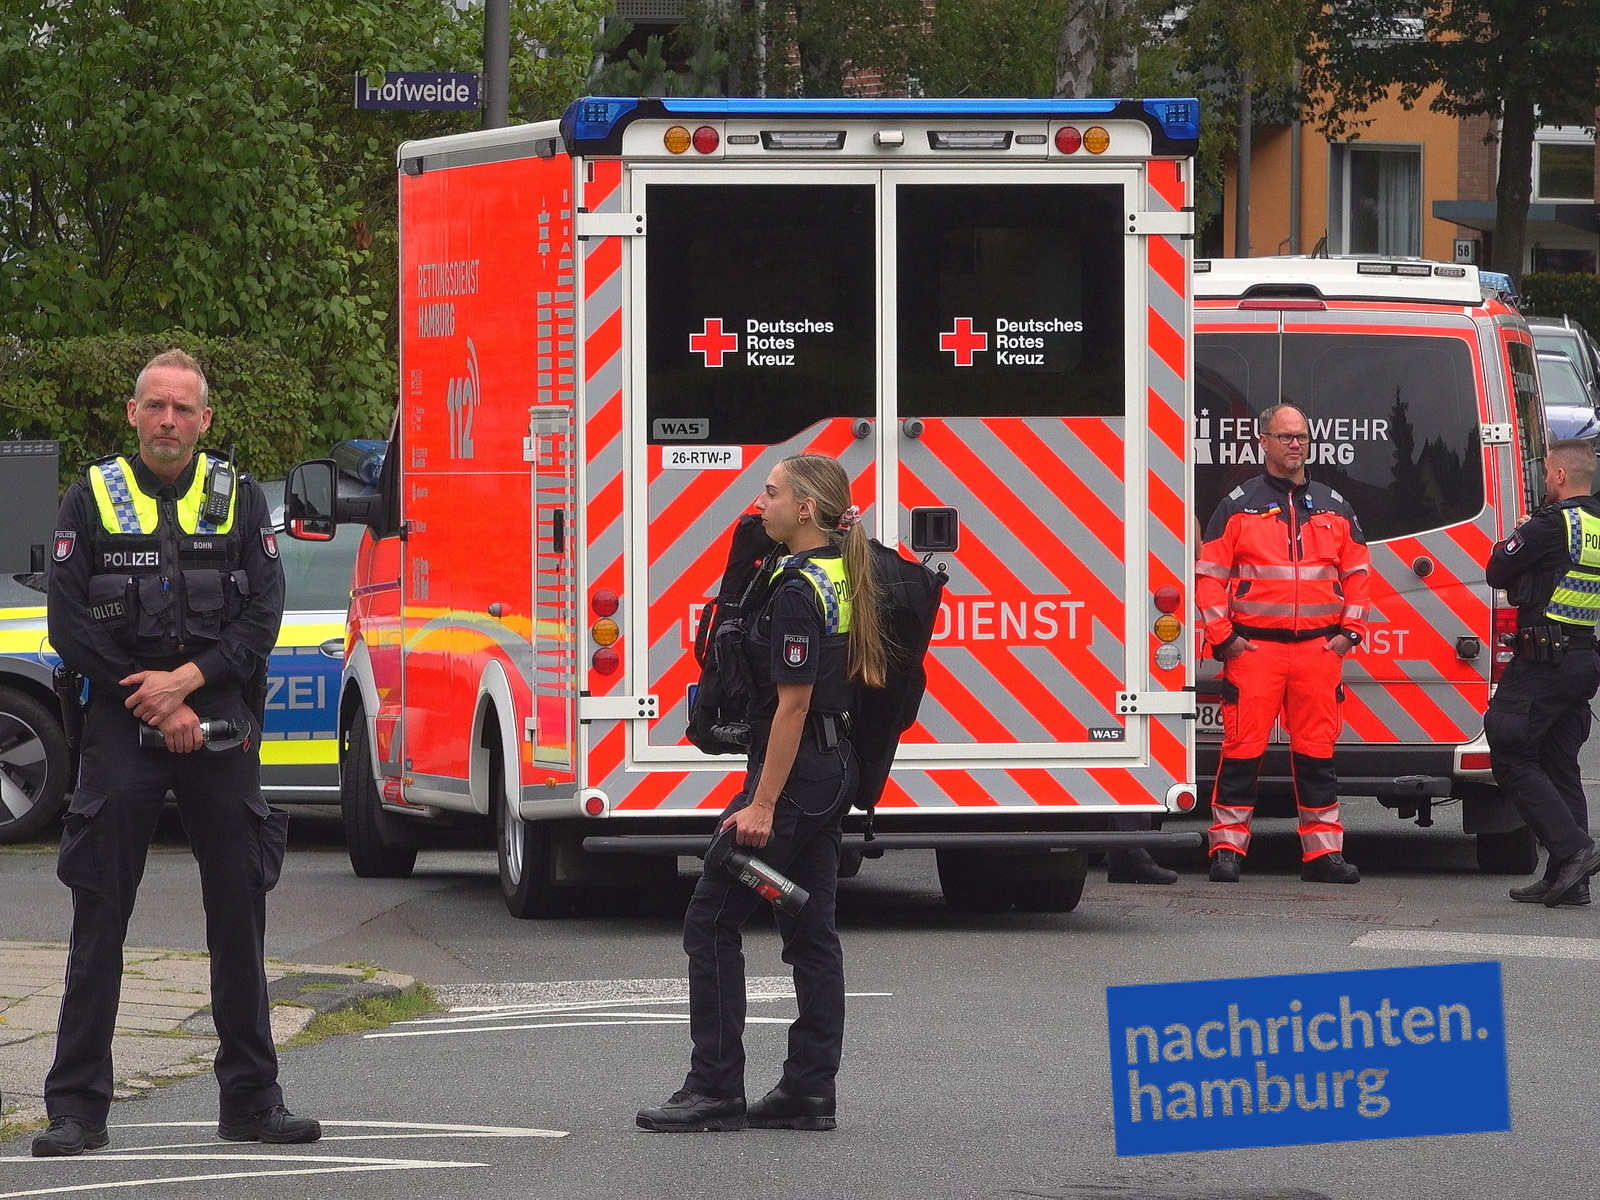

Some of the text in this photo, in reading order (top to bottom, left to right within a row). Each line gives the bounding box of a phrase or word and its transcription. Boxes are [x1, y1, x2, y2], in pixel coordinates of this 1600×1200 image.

[365, 78, 470, 102] Hofweide
[1457, 245, 1470, 257] 58
[418, 259, 480, 298] RETTUNGSDIENST
[418, 303, 455, 338] HAMBURG
[746, 319, 834, 333] Deutsches
[996, 318, 1083, 332] Deutsches
[746, 336, 795, 350] Rotes
[996, 335, 1045, 348] Rotes
[746, 352, 795, 366] Kreuz
[996, 351, 1045, 365] Kreuz
[447, 377, 474, 459] 112
[1220, 418, 1389, 441] FEWEHR
[672, 452, 732, 464] 26-RTW-P
[1220, 443, 1355, 465] HAURG
[193, 541, 213, 549] BOHN
[103, 552, 159, 567] POLIZEI
[1092, 730, 1119, 739] WAS
